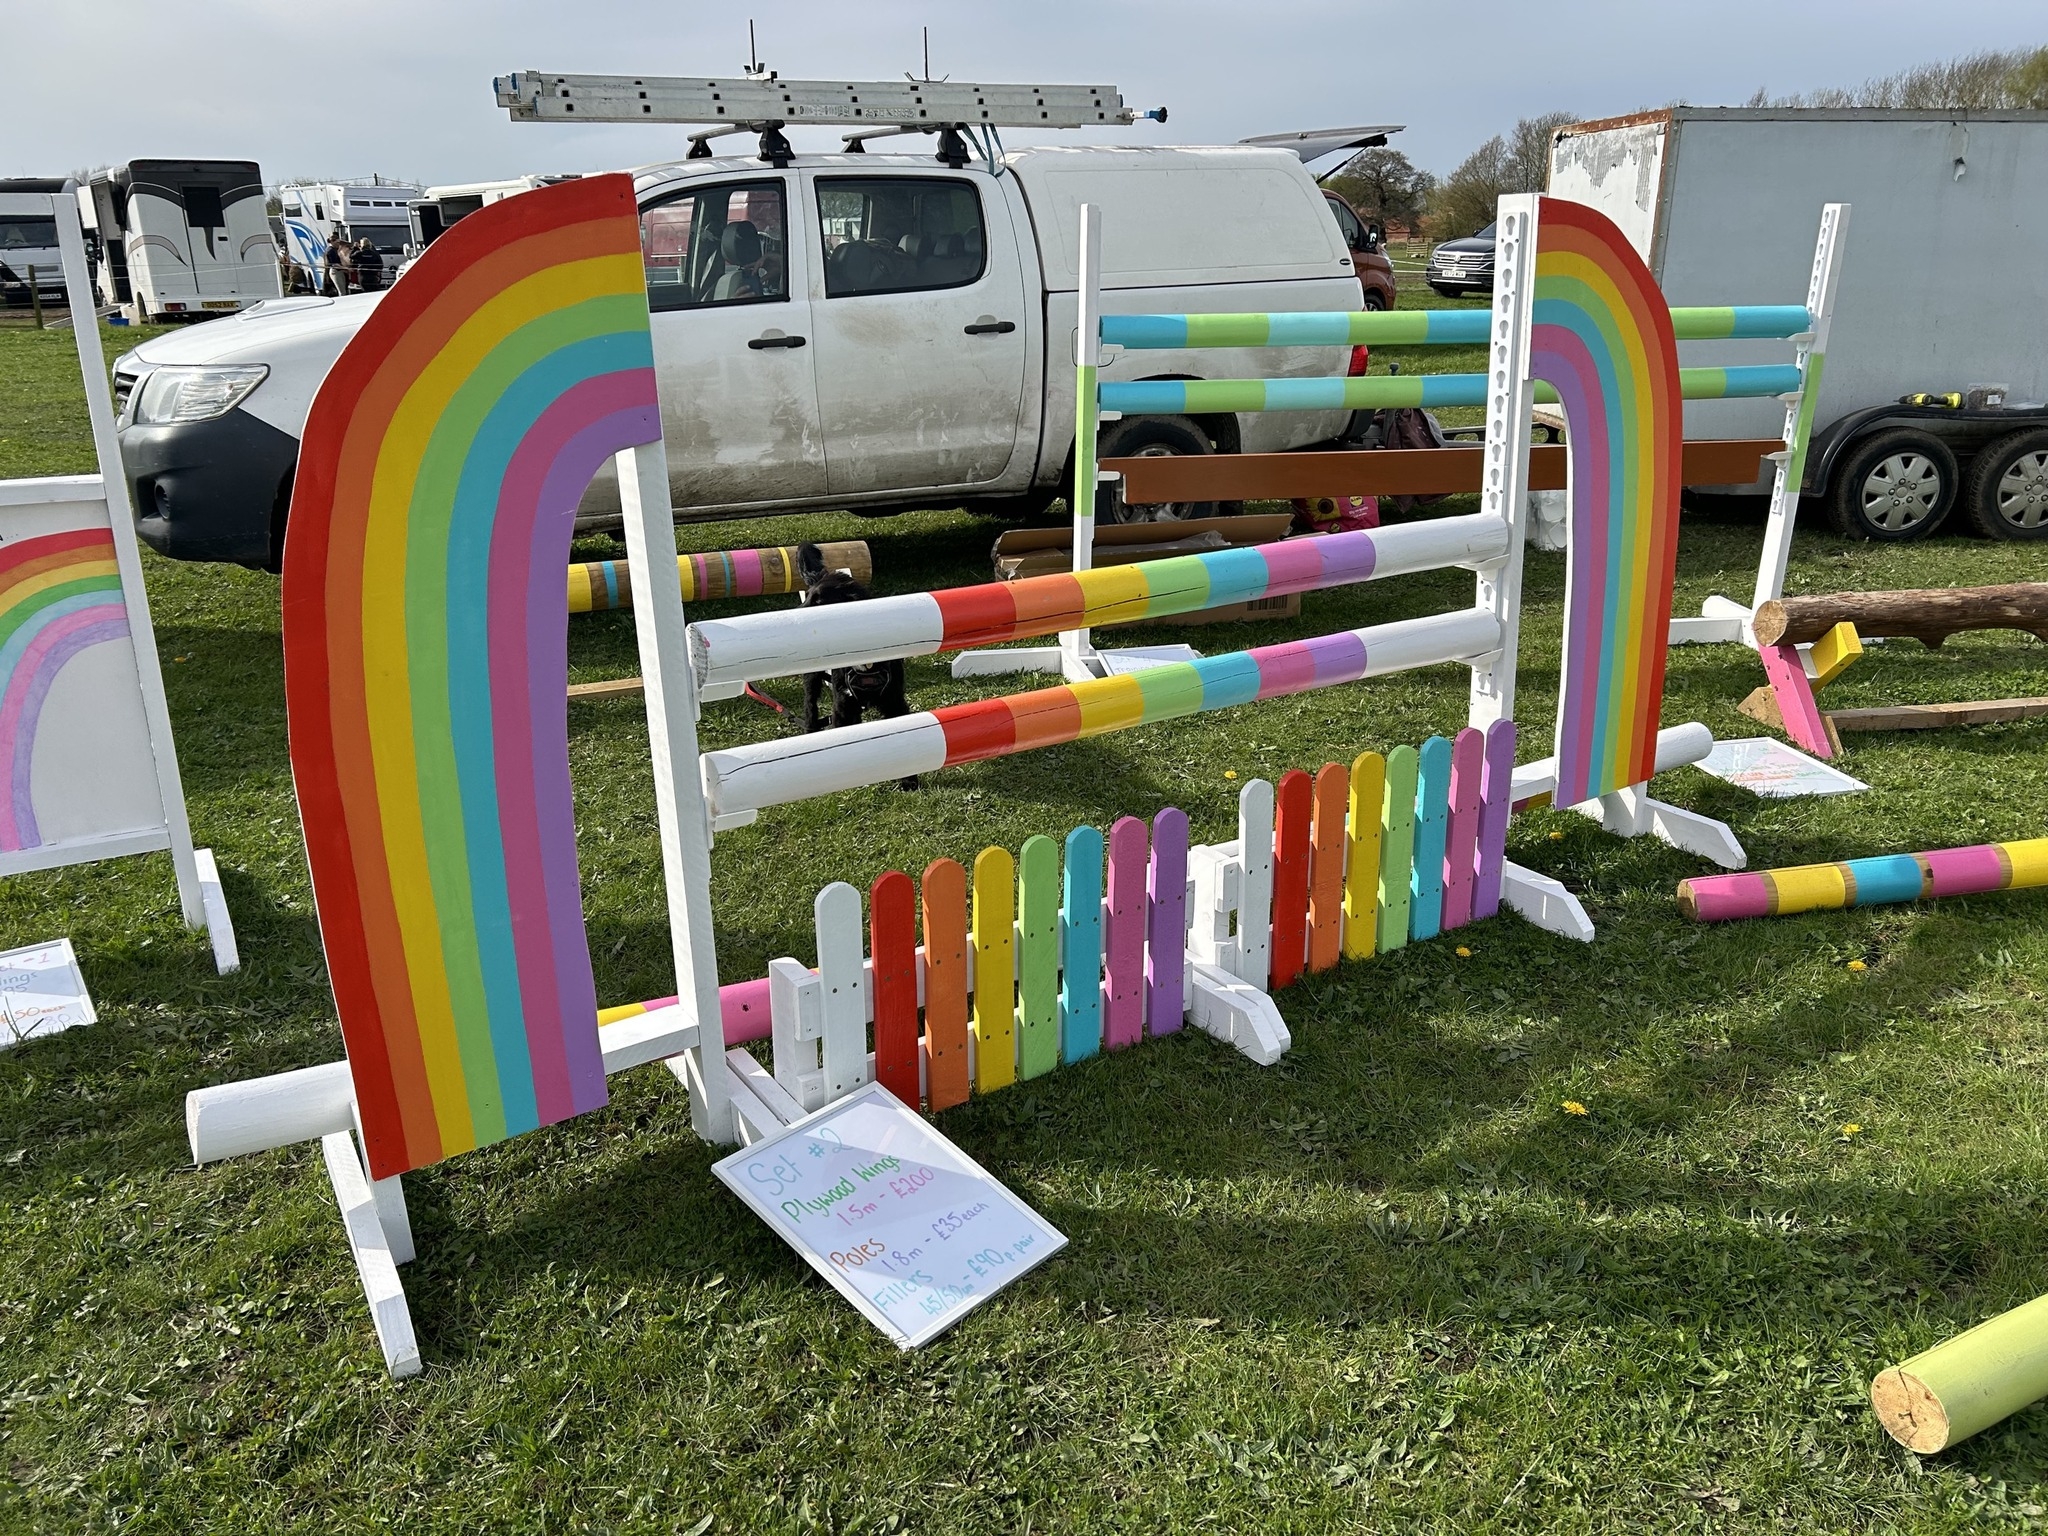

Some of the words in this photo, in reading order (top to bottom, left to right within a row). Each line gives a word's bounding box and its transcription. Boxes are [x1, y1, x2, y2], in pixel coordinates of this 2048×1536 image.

[0, 971, 38, 988] ings
[748, 1154, 802, 1196] Set
[781, 1176, 856, 1223] Plywood
[852, 1155, 900, 1182] Wings
[837, 1204, 878, 1226] 1.5m
[889, 1166, 935, 1199] £200
[830, 1237, 885, 1273] Poles
[881, 1247, 923, 1272] 1.8m
[967, 1248, 1005, 1278] £90
[873, 1269, 933, 1312] Fillers
